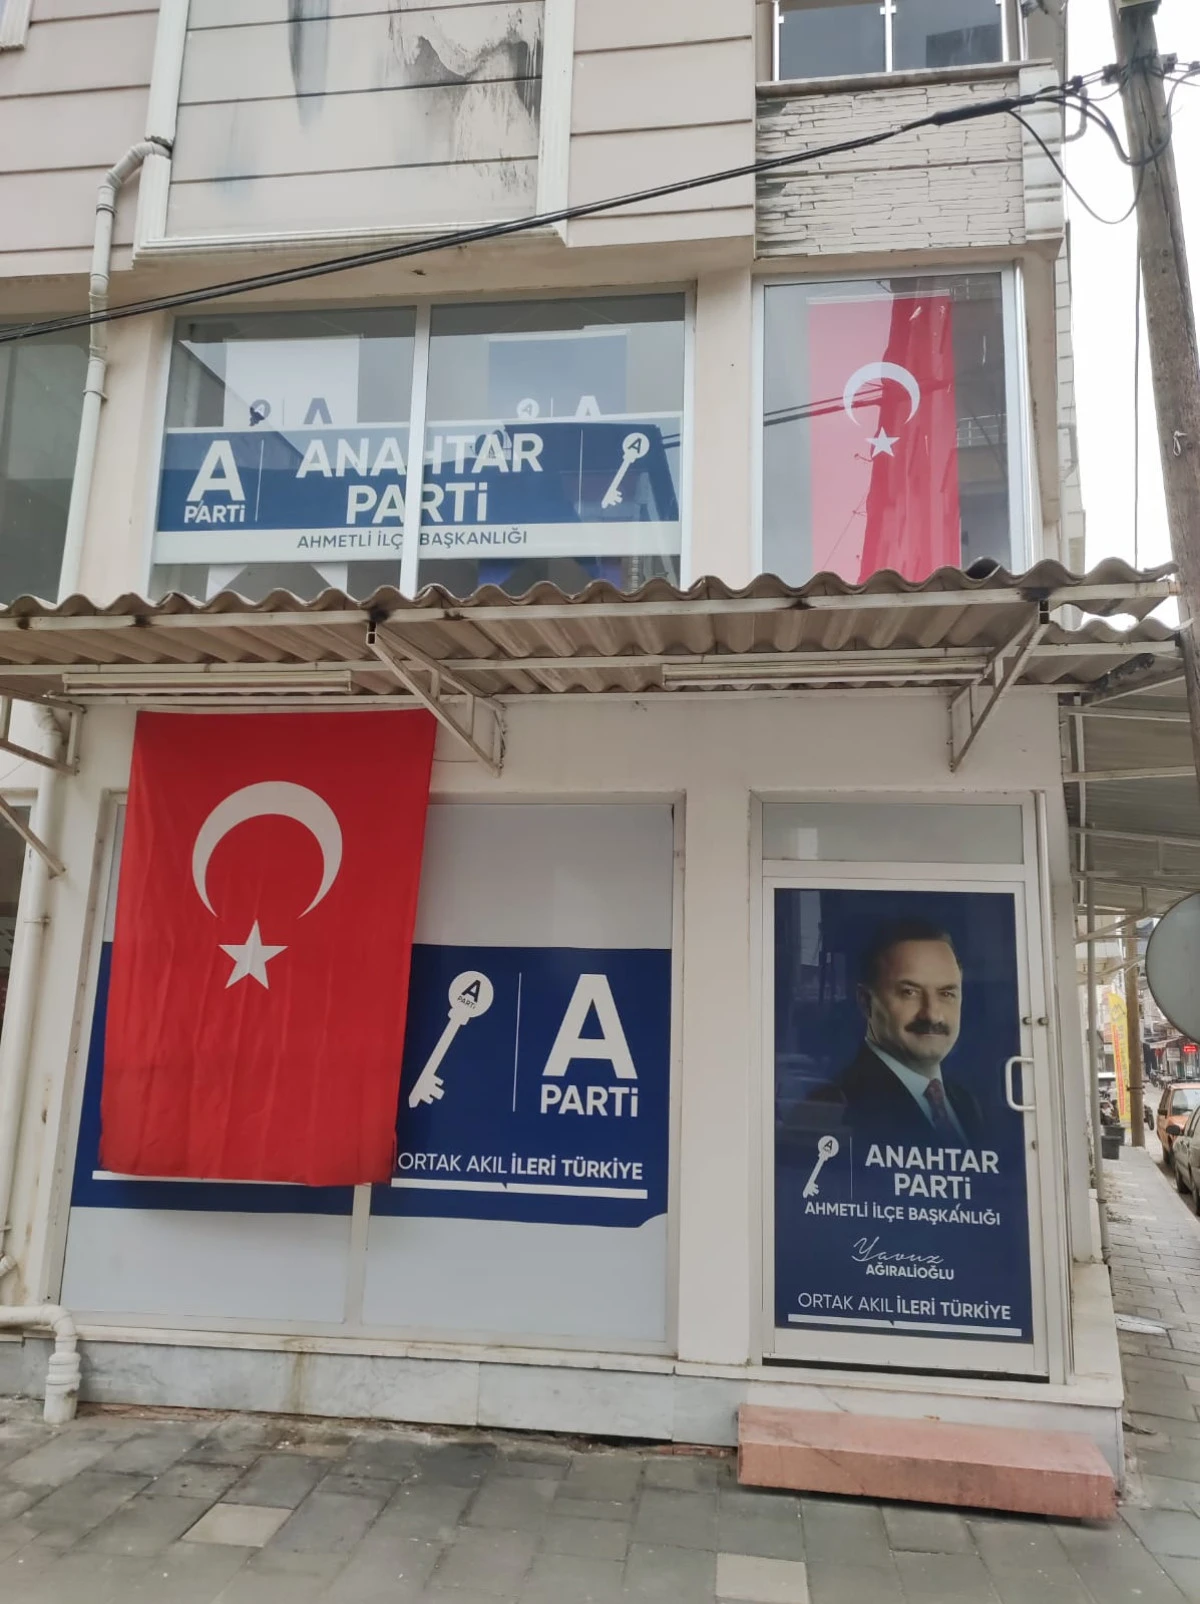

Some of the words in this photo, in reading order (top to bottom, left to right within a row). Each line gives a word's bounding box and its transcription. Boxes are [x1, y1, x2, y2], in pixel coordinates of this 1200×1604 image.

[296, 432, 544, 479] ANAHTAR
[627, 437, 644, 454] A
[186, 439, 246, 502] A
[297, 529, 373, 549] AHMETLİ
[377, 529, 404, 550] İLÇ
[419, 527, 528, 549] BAŞKANLIĞI
[461, 979, 481, 1003] A
[541, 973, 638, 1080] A
[540, 1083, 639, 1118] PARTi
[397, 1152, 462, 1172] ORTAK
[466, 1155, 507, 1174] AKIL
[511, 1152, 556, 1176] İLERİ
[561, 1155, 643, 1181] TÜRKİYE
[865, 1144, 1000, 1174] ANAHTAR
[893, 1173, 971, 1200] PARTi
[804, 1200, 868, 1218] AHMETLİ
[872, 1201, 904, 1223] İLÇE
[908, 1205, 1001, 1226] BAŞKANLIĞI
[851, 1236, 944, 1264] Yavuz
[865, 1261, 955, 1281] AĞIRALİOĞLU
[797, 1292, 854, 1311] ORTAK
[858, 1296, 894, 1313] AKIL
[896, 1295, 936, 1316] İLERİ
[940, 1299, 1012, 1320] TÜRKİYE
